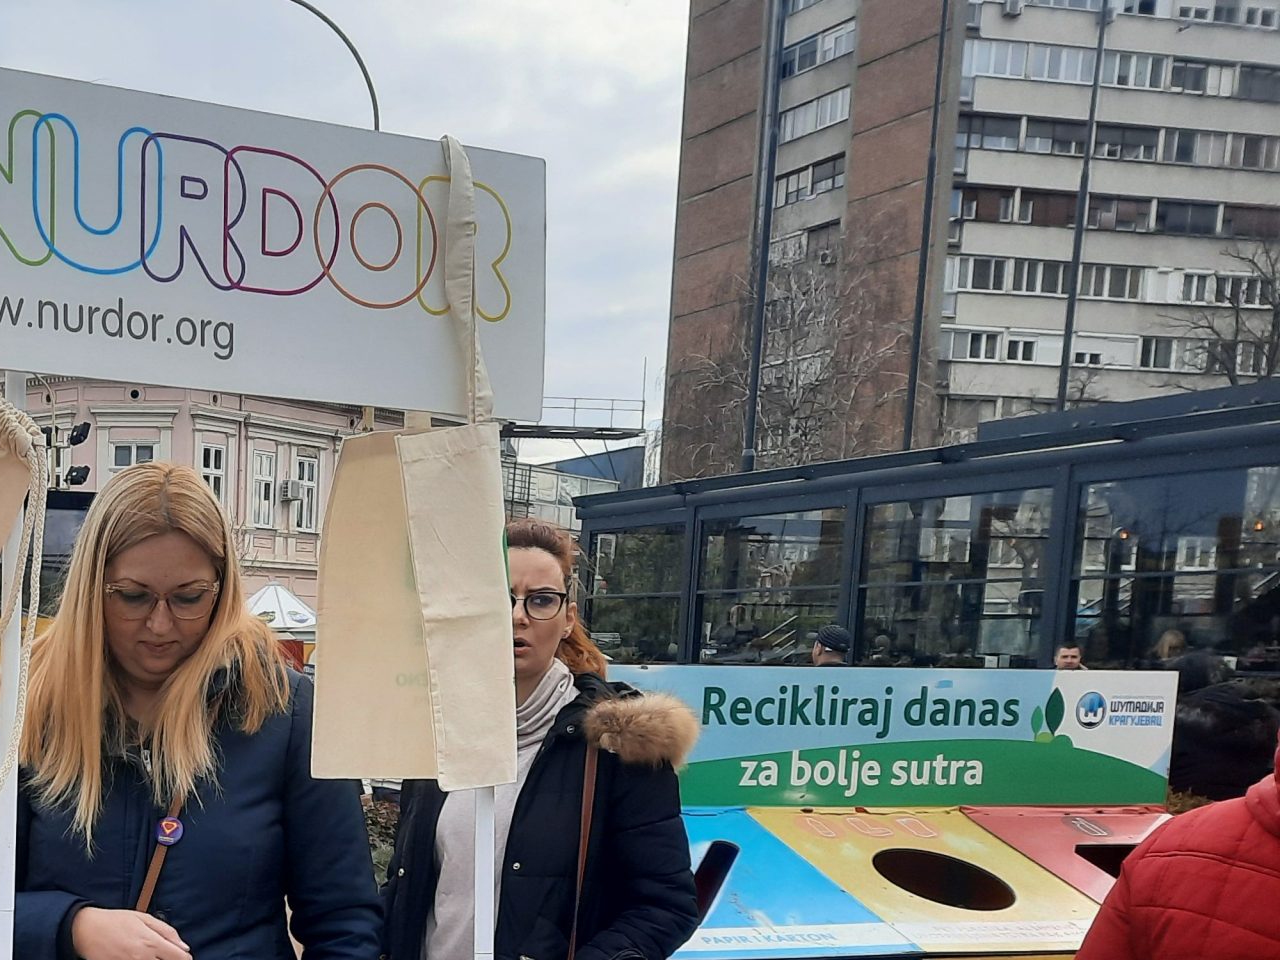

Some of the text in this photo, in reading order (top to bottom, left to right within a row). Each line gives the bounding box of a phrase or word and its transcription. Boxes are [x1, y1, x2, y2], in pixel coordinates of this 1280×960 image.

[702, 685, 1020, 739] Recikliraj danas
[739, 749, 984, 798] za bolje sutra
[761, 932, 838, 943] KARTON
